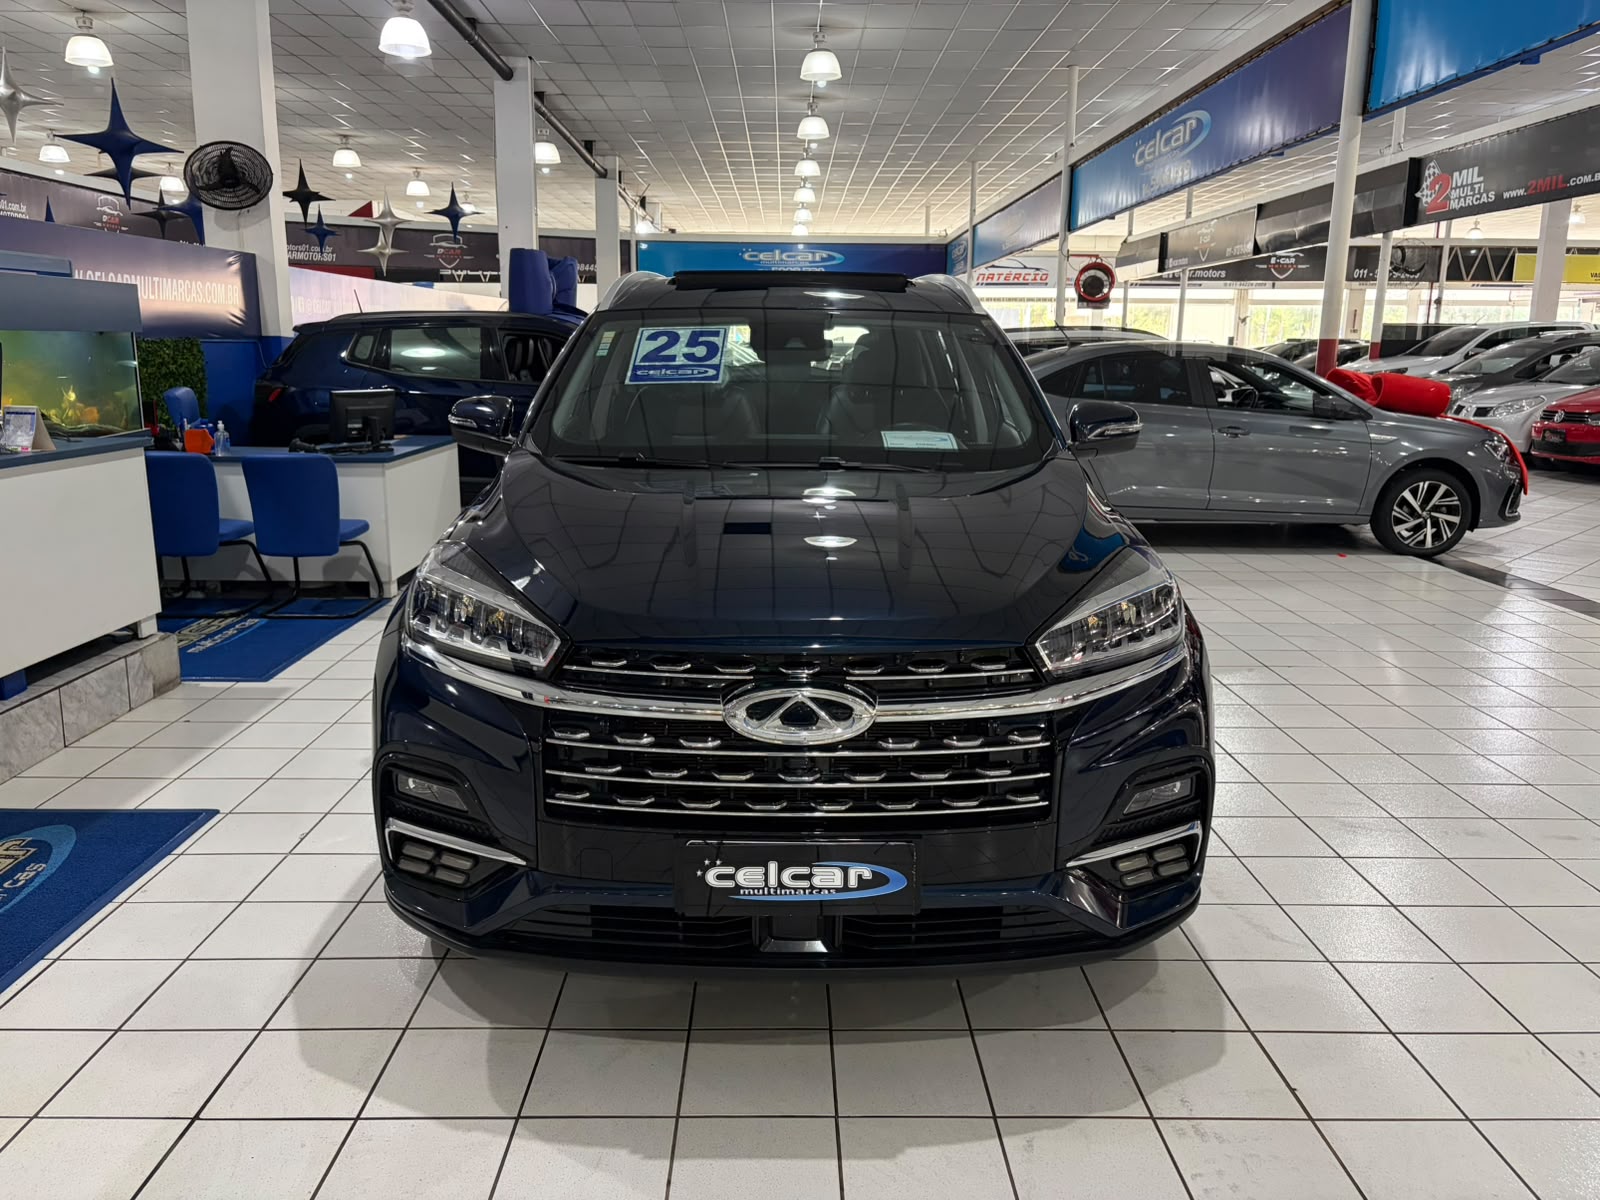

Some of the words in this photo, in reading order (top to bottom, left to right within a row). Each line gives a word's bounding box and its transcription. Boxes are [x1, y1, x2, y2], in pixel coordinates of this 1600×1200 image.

[1135, 119, 1197, 167] celcar
[1426, 173, 1451, 214] 2
[1452, 167, 1484, 187] MIL
[1451, 183, 1485, 198] MULTI
[1450, 191, 1496, 210] MARCAS
[743, 245, 828, 262] celcar
[1353, 268, 1367, 279] 011
[639, 330, 720, 363] 25
[705, 861, 873, 888] celcar
[740, 887, 837, 896] multimarcas
